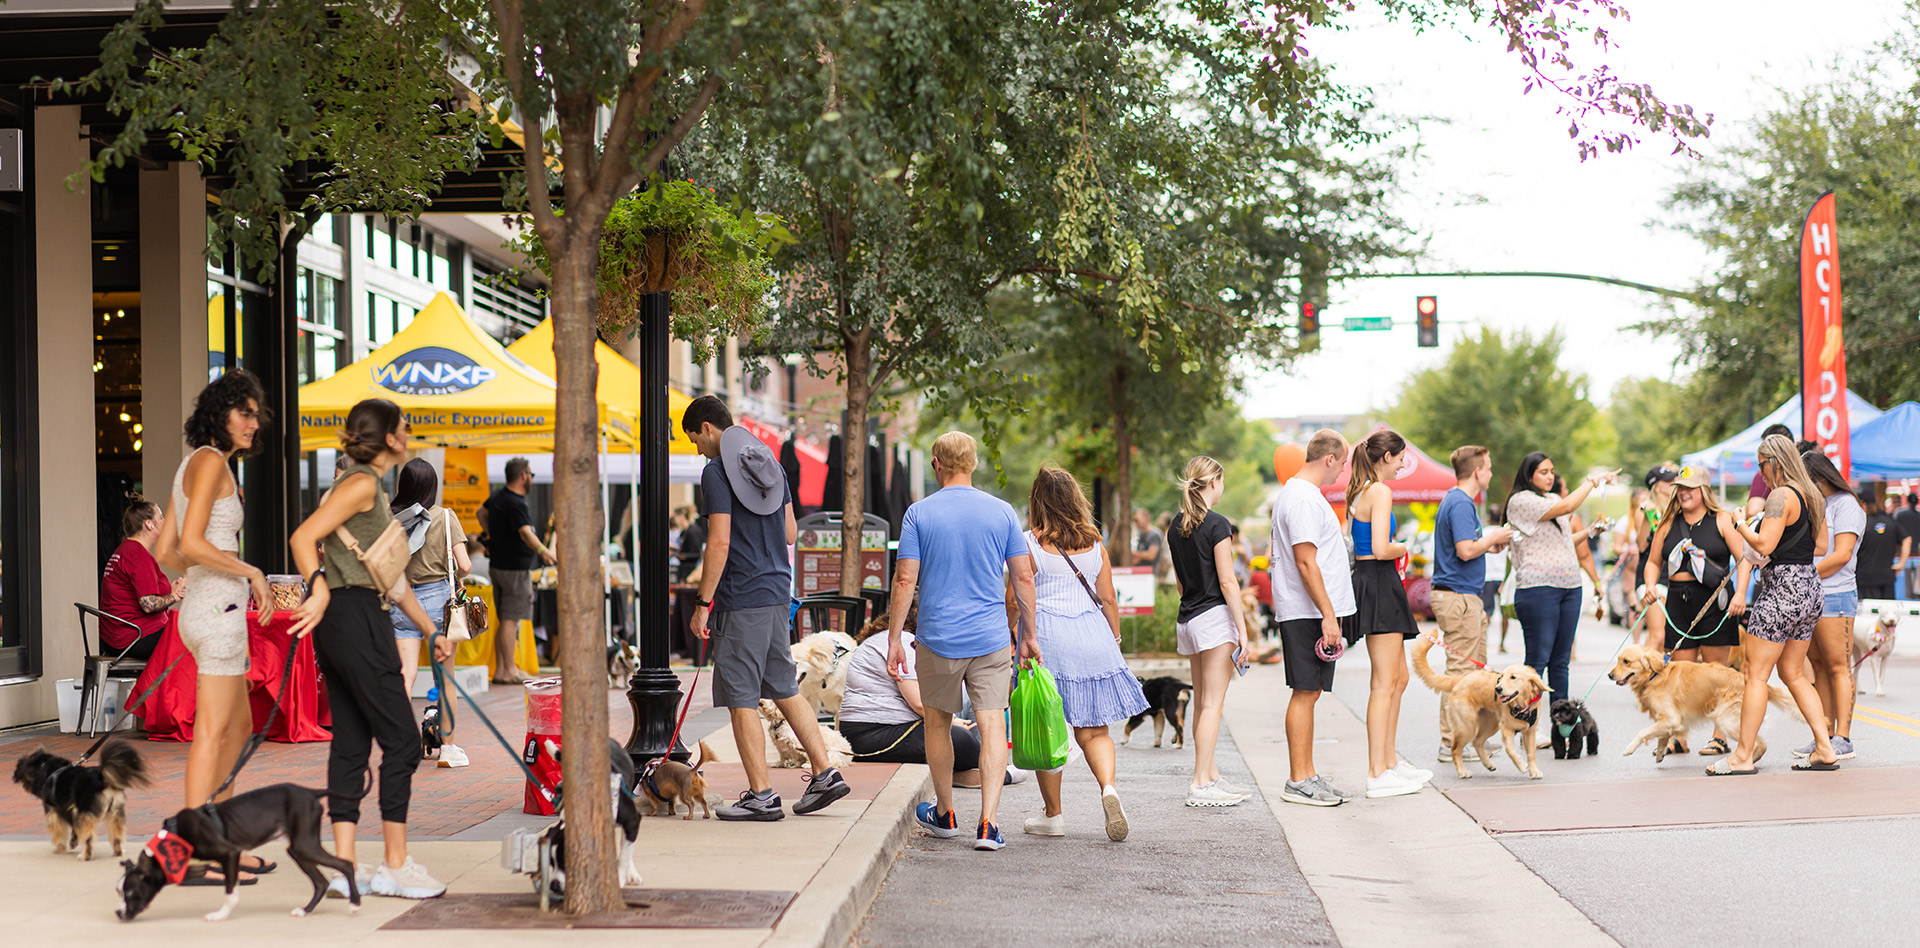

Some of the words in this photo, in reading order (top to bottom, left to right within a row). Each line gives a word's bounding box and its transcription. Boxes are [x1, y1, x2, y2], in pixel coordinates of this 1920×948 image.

[1810, 222, 1831, 326] HOT
[371, 361, 497, 385] WNXP
[402, 411, 445, 425] Music
[451, 412, 545, 427] Experience
